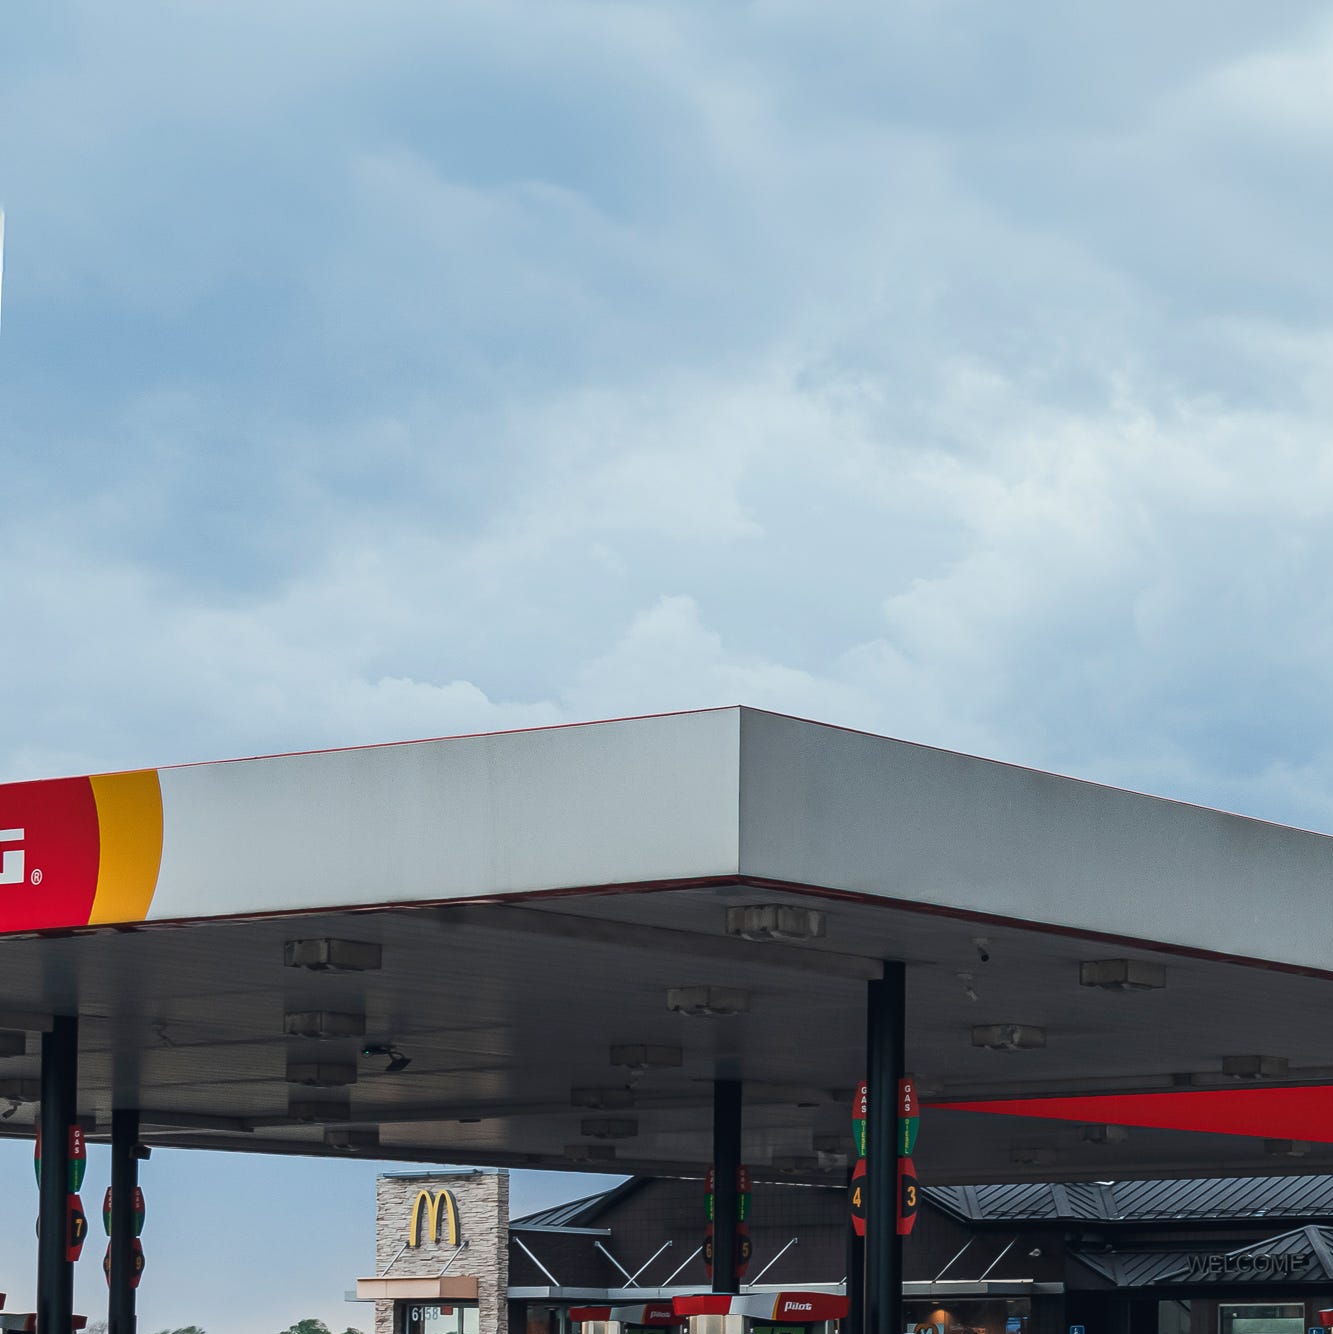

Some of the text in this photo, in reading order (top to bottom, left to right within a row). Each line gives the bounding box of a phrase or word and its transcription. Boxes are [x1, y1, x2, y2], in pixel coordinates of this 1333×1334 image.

[852, 1187, 862, 1208] 4
[907, 1186, 916, 1207] 3
[75, 1218, 83, 1238] 7
[1186, 1253, 1306, 1273] WELCOME
[411, 1307, 440, 1322] 6158
